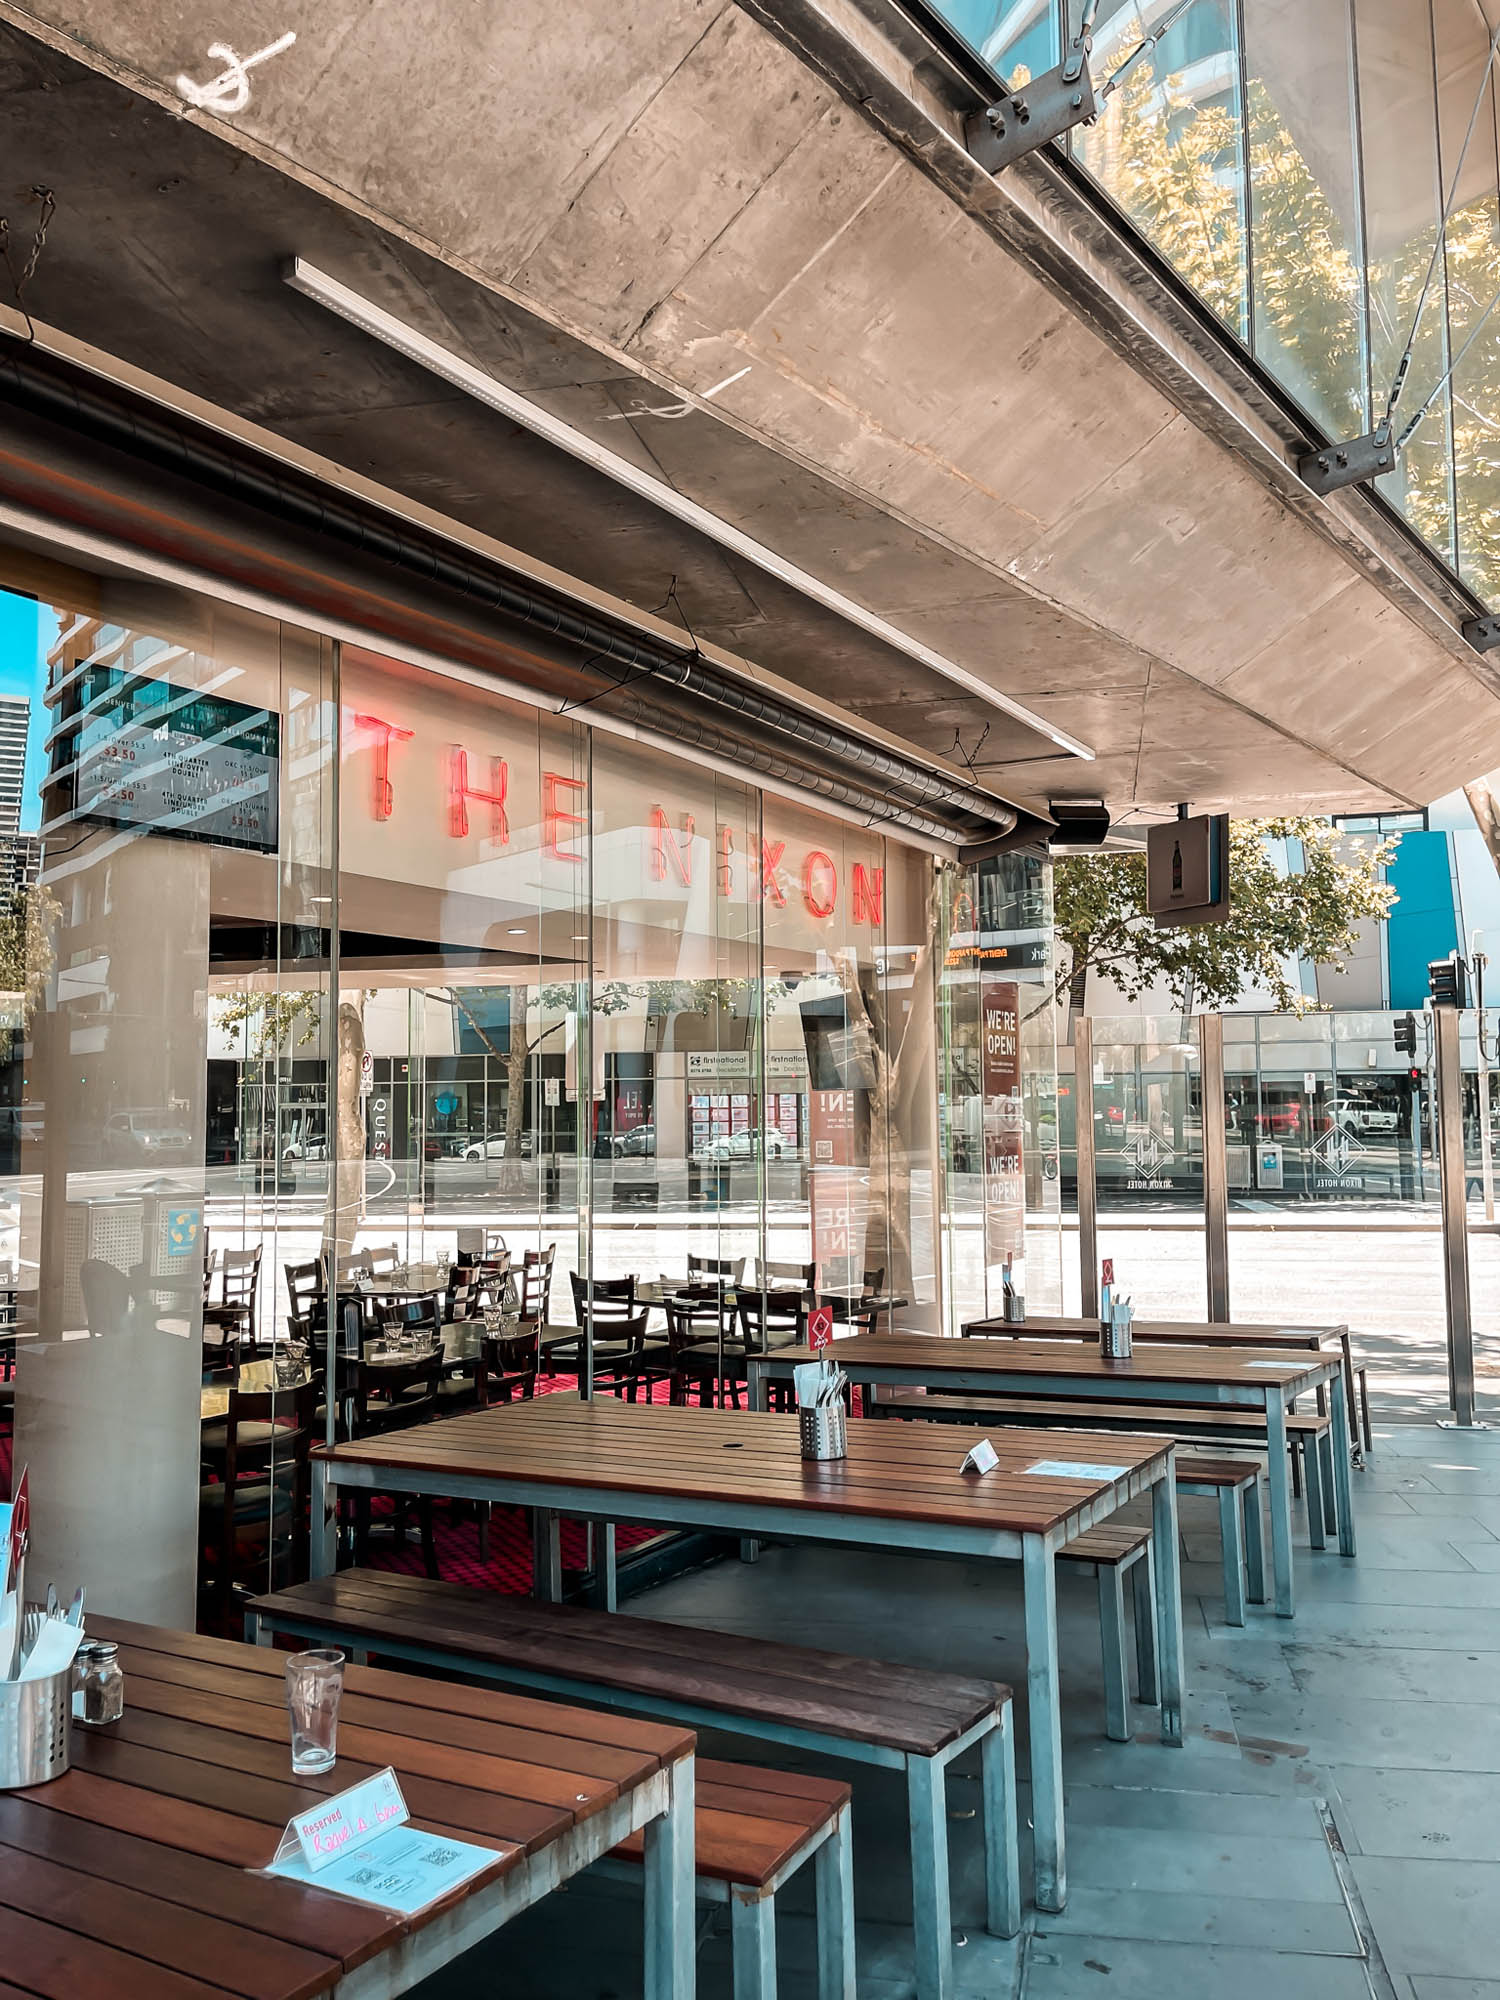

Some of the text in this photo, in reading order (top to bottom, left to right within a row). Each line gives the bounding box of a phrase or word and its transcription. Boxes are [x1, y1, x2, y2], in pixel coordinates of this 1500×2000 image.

[354, 712, 884, 927] THE NIXON
[986, 1008, 1016, 1031] WE'RE
[987, 1034, 1016, 1056] OPEN!
[303, 1808, 342, 1837] Reserved
